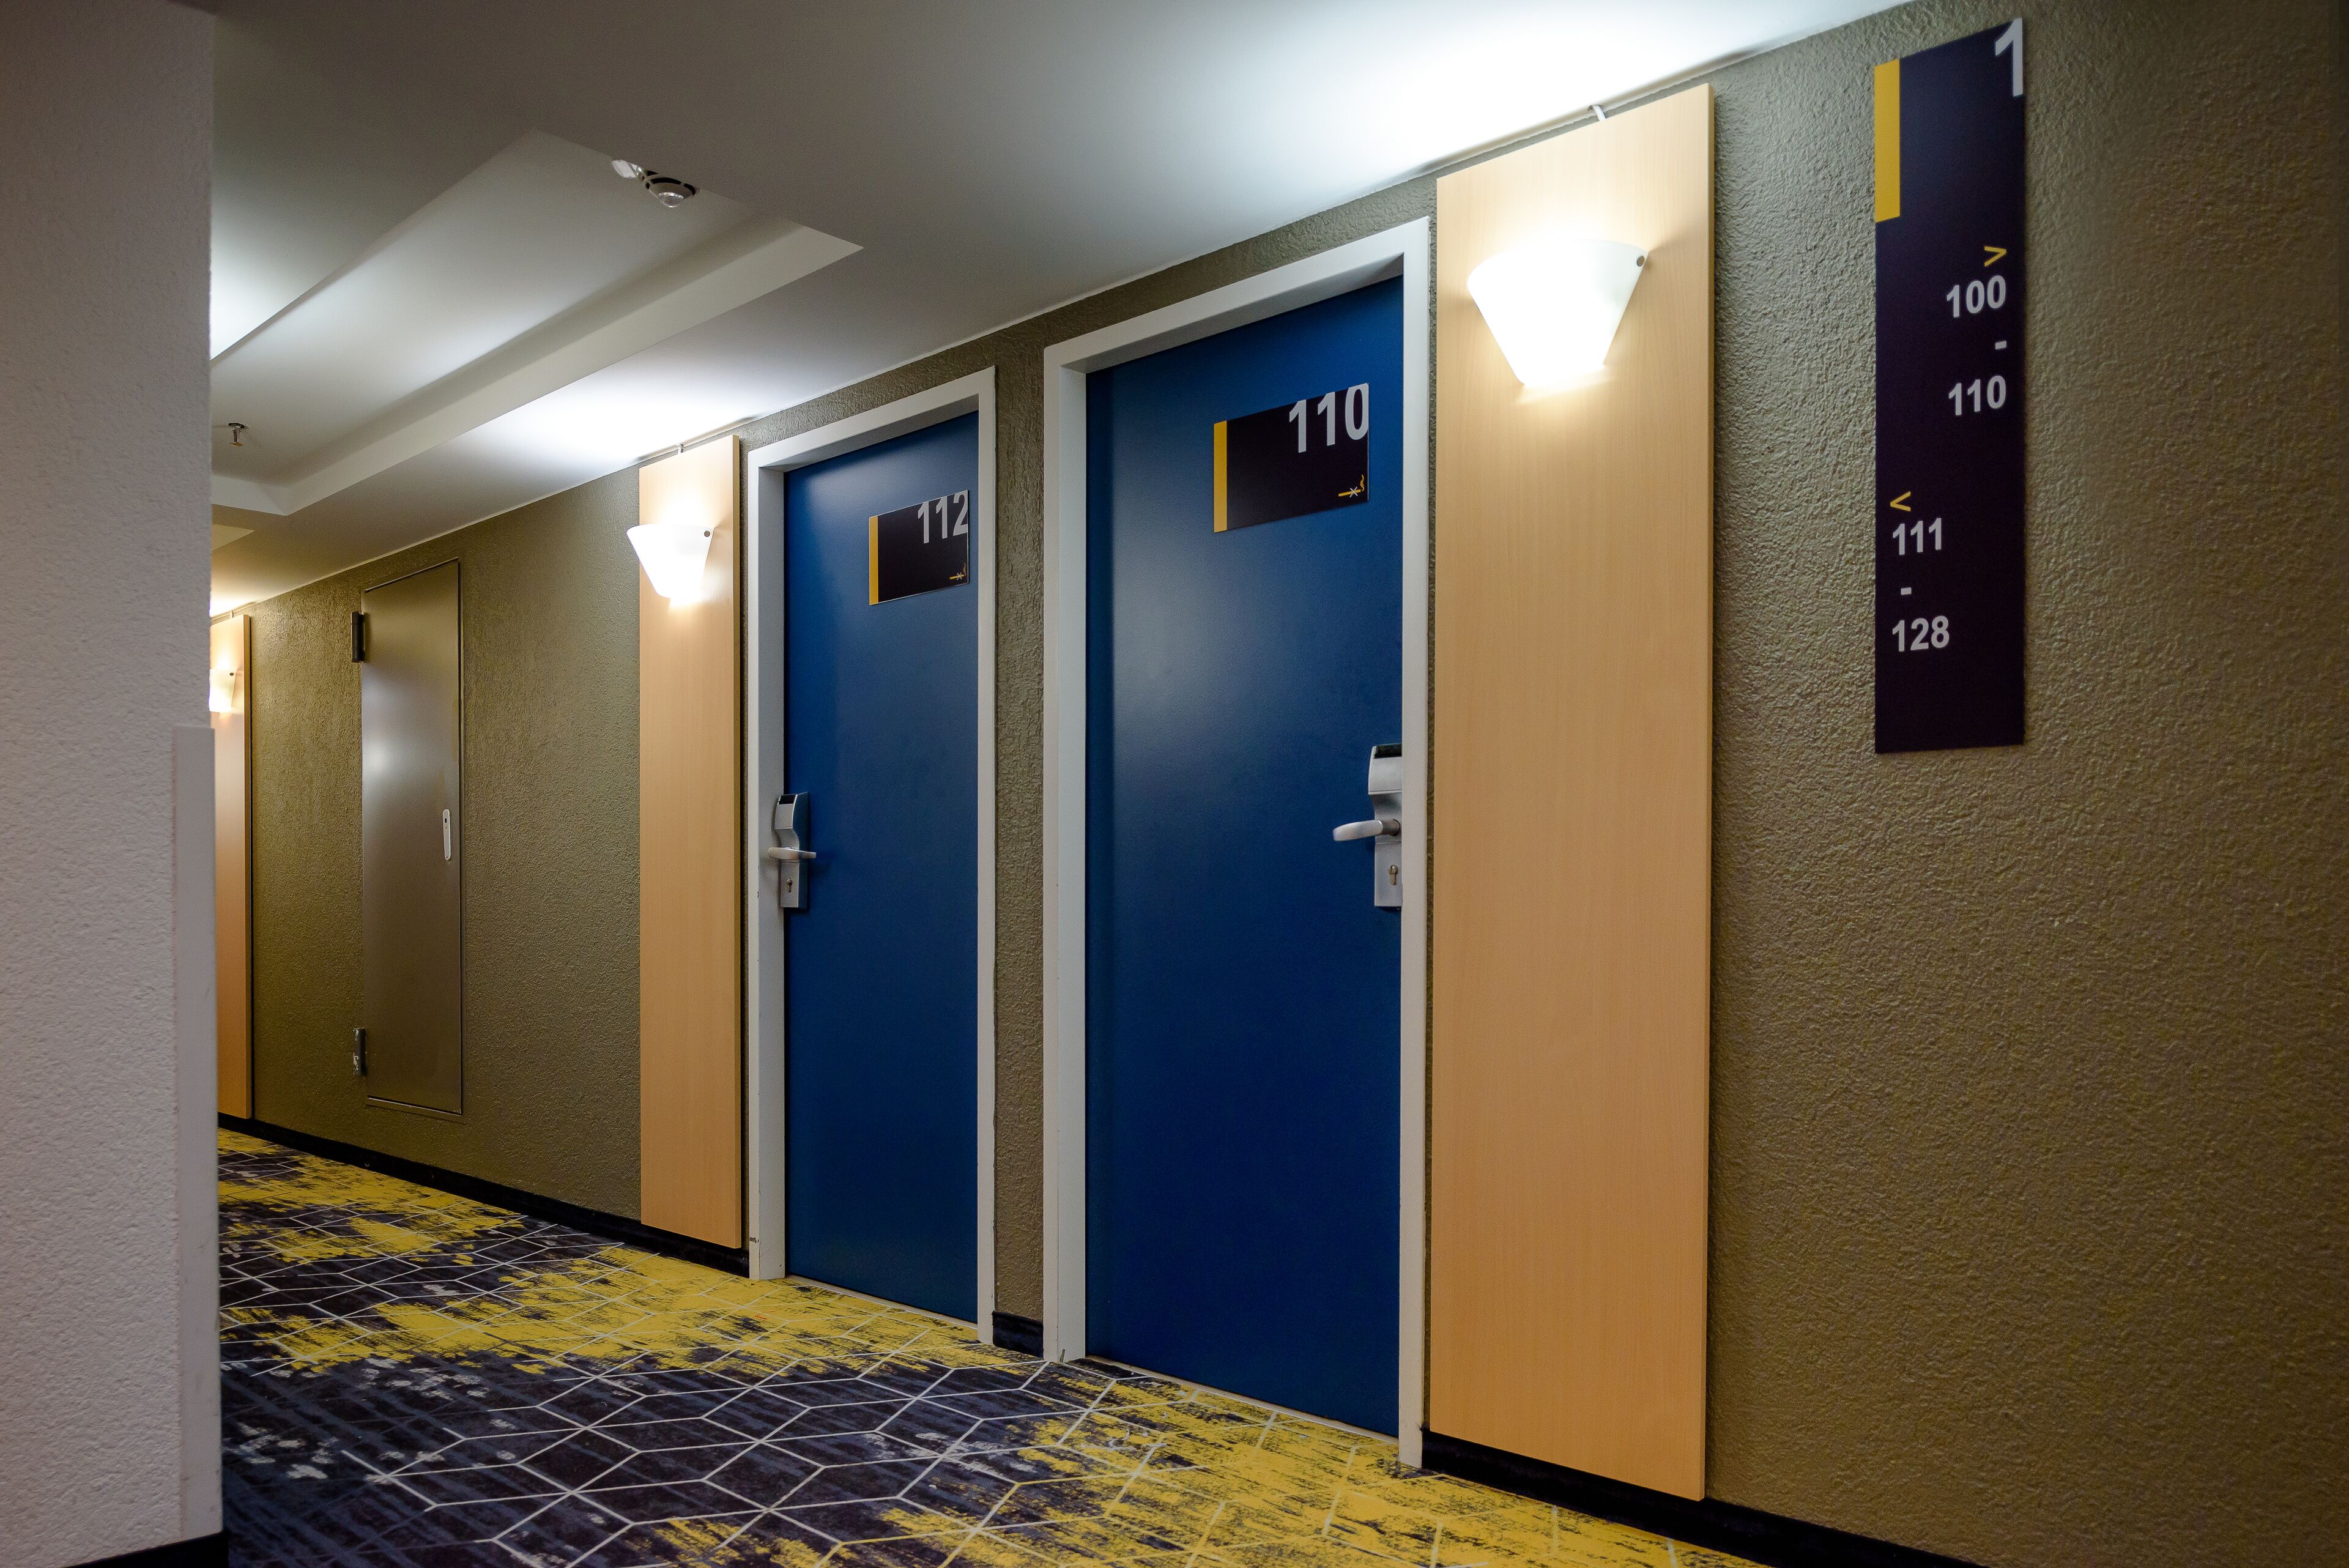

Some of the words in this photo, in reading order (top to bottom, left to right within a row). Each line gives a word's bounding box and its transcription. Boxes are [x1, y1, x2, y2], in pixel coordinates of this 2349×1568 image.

[1995, 18, 2023, 97] 1
[1946, 275, 2006, 318] 100
[1289, 382, 1369, 453] 110
[1948, 375, 2006, 417] 110
[918, 489, 968, 544] 112
[1892, 518, 1942, 555] 111
[1891, 615, 1950, 652] 128
